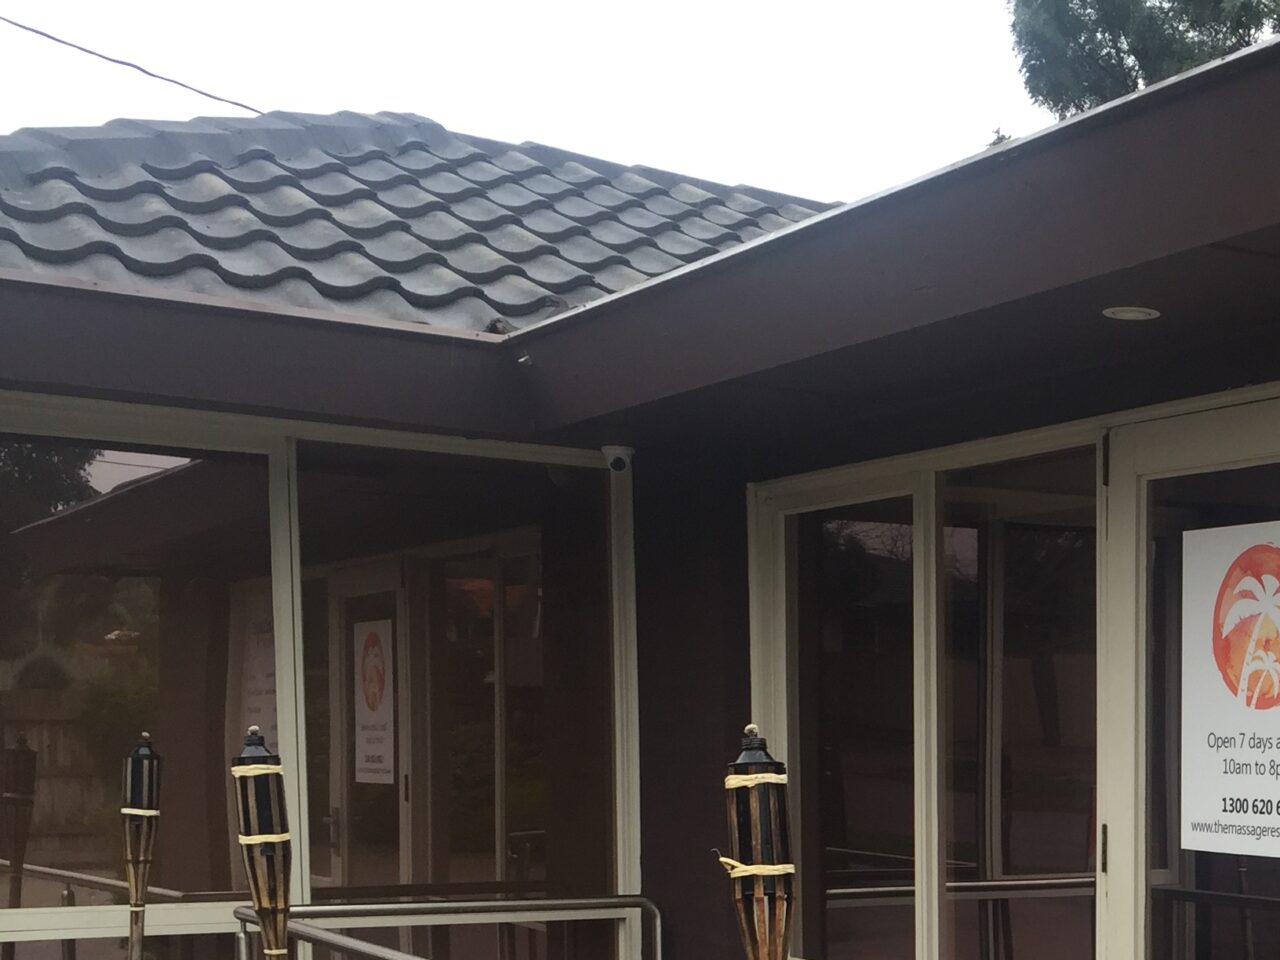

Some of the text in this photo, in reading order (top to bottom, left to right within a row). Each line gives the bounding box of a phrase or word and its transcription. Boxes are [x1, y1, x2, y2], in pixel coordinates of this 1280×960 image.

[1207, 732, 1236, 752] Open
[1239, 733, 1245, 749] 7
[1248, 732, 1273, 754] days
[1223, 758, 1252, 775] 10am
[1255, 760, 1266, 775] to
[1222, 797, 1249, 814] 1300
[1252, 799, 1273, 815] 620
